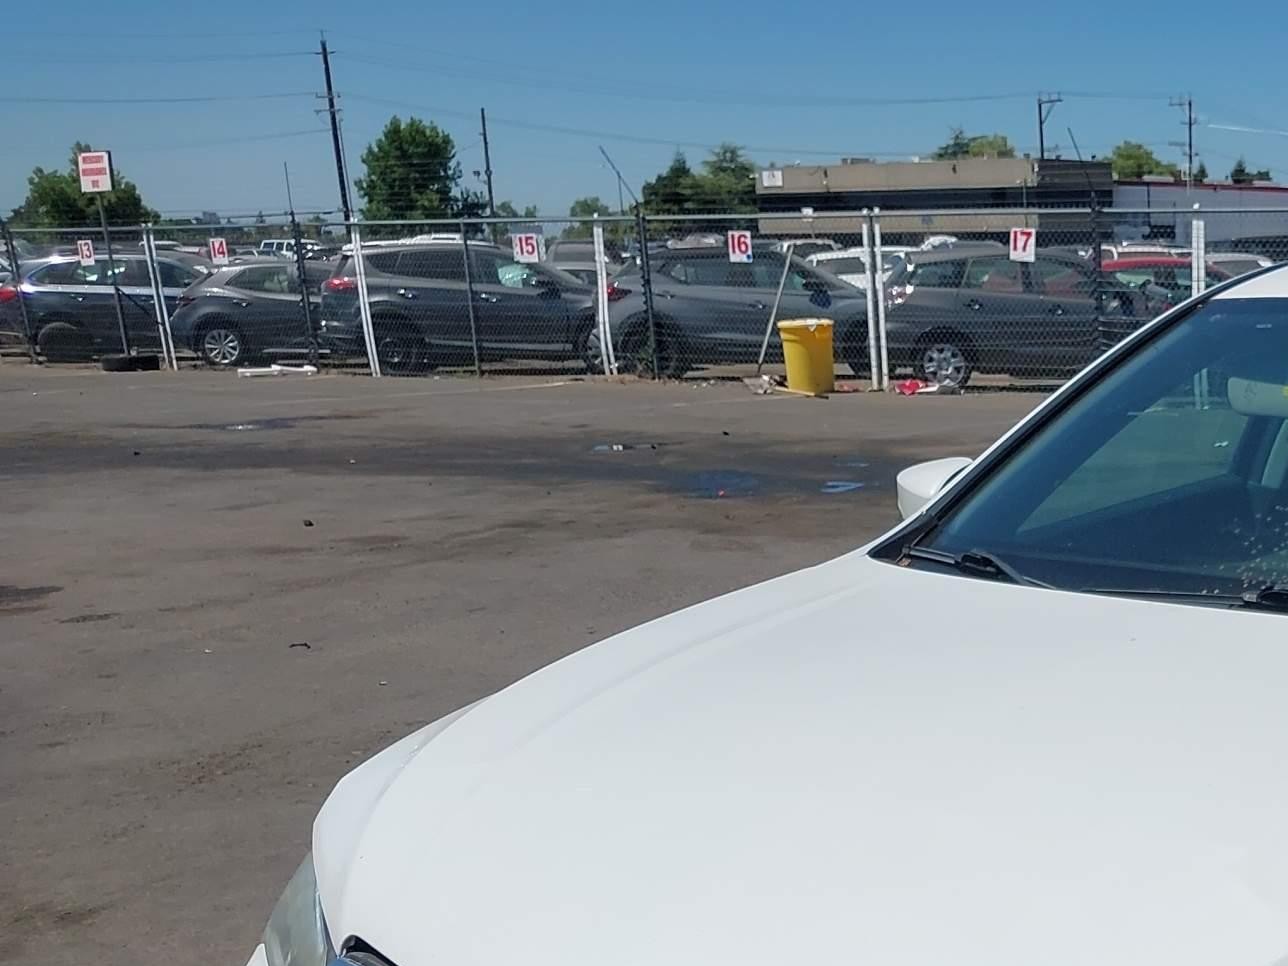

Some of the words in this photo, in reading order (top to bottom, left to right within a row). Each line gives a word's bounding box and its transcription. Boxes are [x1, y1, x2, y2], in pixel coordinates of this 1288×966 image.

[79, 242, 92, 260] 13
[211, 240, 226, 257] 14
[518, 235, 536, 255] 15
[731, 233, 749, 254] 16
[1012, 230, 1033, 252] 17
